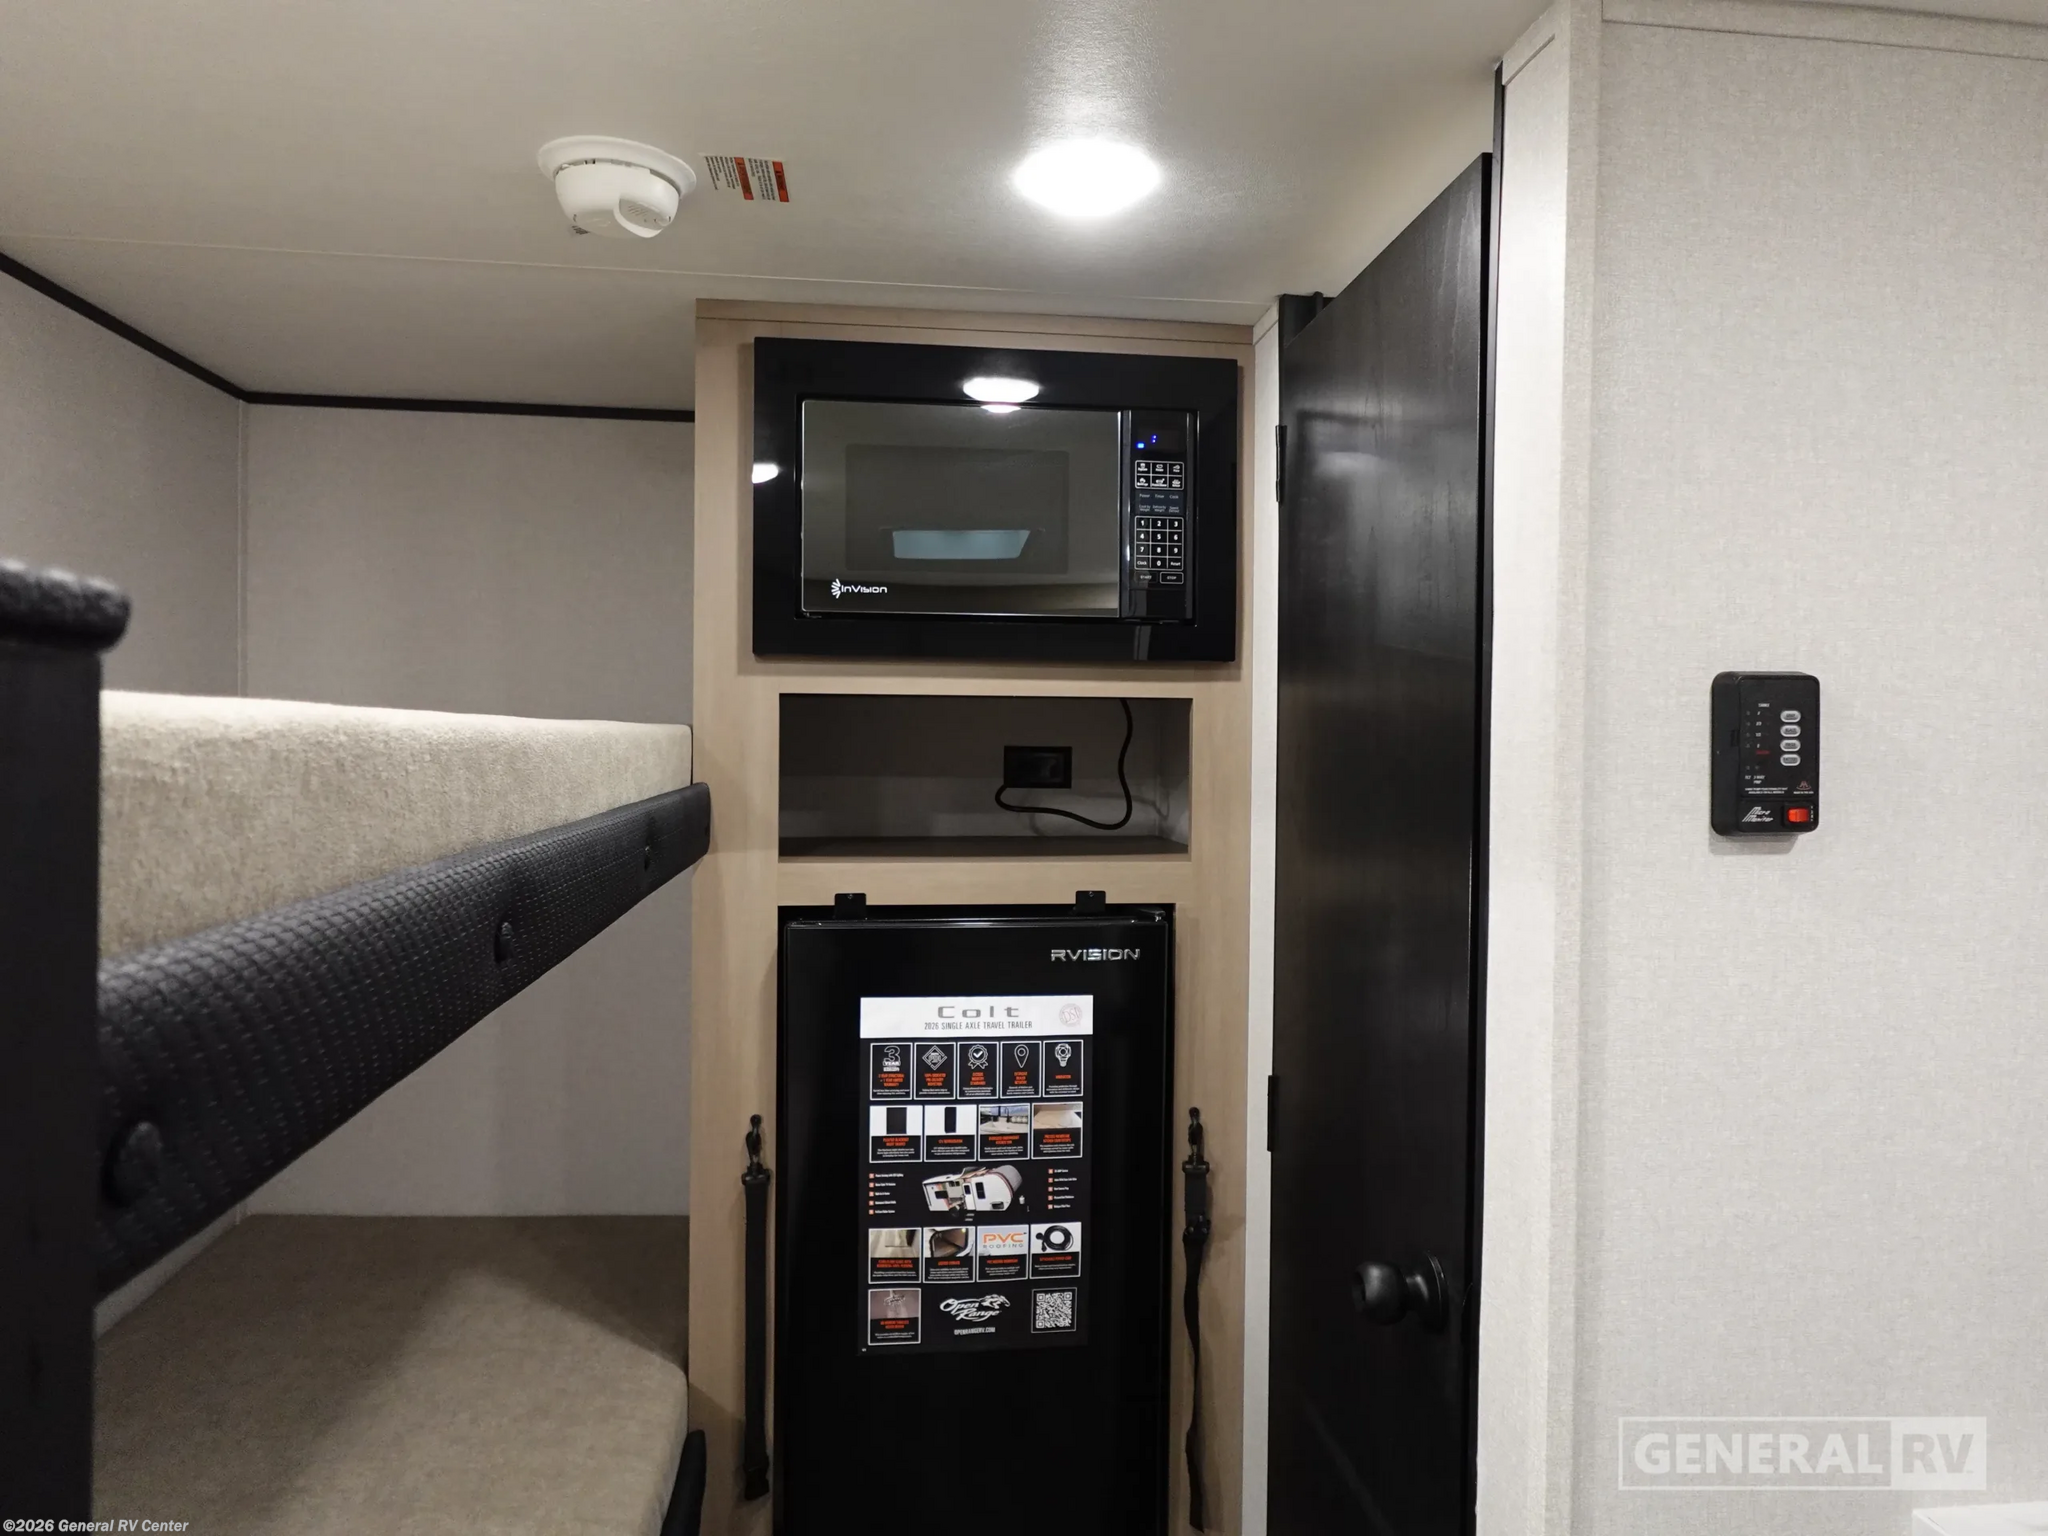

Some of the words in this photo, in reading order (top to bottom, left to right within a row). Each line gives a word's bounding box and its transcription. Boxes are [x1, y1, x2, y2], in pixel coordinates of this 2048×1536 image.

[1051, 948, 1140, 961] RVISION
[937, 1005, 1020, 1019] Colt
[924, 1022, 939, 1030] 2026
[983, 1021, 1005, 1029] TRAVEL
[983, 1233, 1024, 1243] PVC
[940, 1298, 980, 1315] Open
[955, 1308, 1000, 1322] Range
